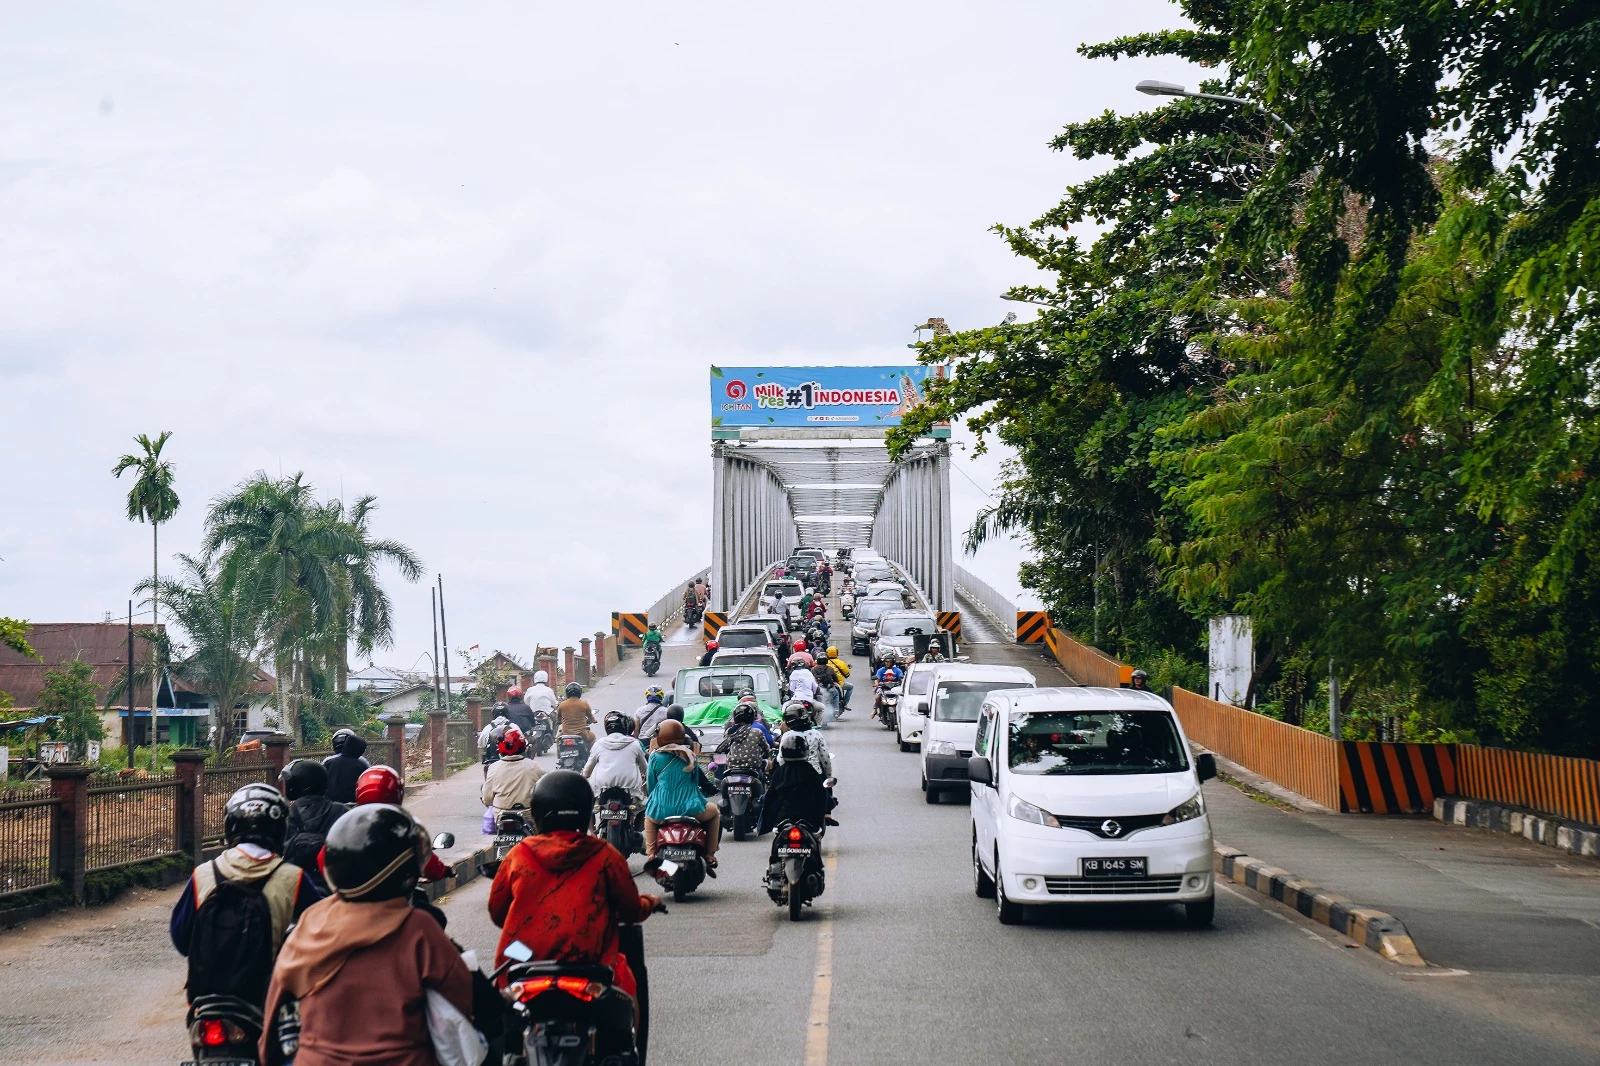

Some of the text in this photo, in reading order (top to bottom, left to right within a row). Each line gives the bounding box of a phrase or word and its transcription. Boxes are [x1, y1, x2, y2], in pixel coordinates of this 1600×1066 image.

[755, 385, 784, 397] Milk
[814, 391, 899, 402] INDONESIA
[760, 395, 785, 406] Tea
[1085, 860, 1144, 870] KB 1645 SM
